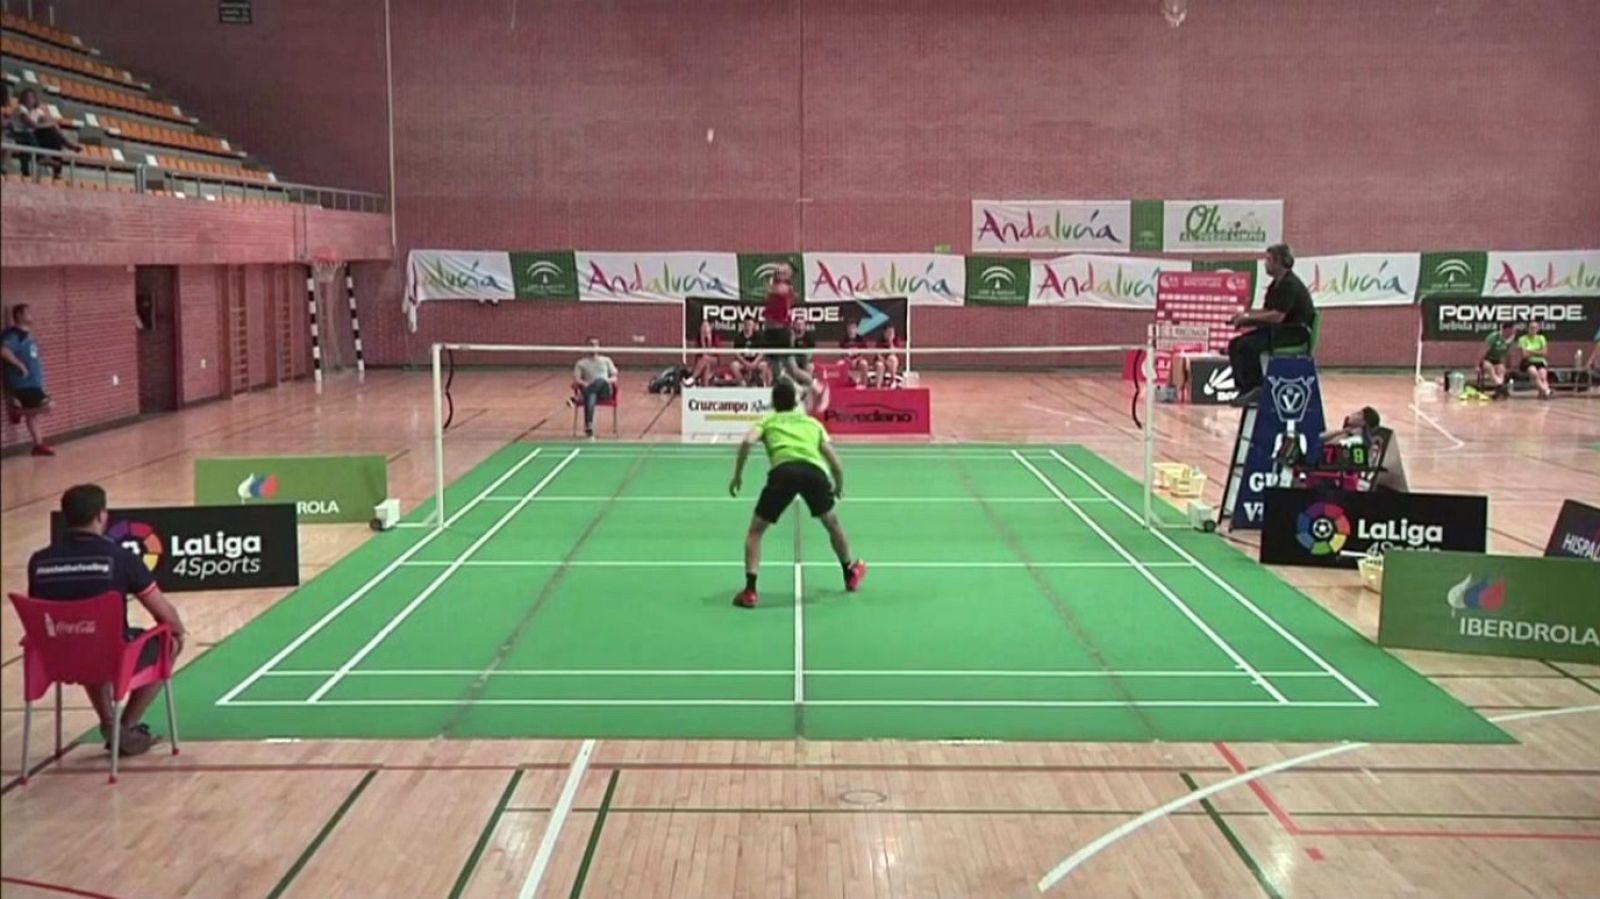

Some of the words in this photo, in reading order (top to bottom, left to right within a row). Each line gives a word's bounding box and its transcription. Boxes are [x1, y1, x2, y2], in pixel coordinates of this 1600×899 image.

[977, 208, 1122, 244] Andalucía
[588, 260, 735, 296] Andalucía
[813, 260, 962, 303] Andalucía
[1037, 261, 1160, 299] Andalucí
[1439, 304, 1584, 322] POWERADE
[688, 398, 748, 414] Cruzcampo
[297, 501, 339, 515] ROLA
[171, 531, 261, 559] LaLiga
[1358, 519, 1443, 545] LaLiga
[172, 557, 261, 580] 4Sports
[1460, 617, 1600, 647] IBERDROLA
